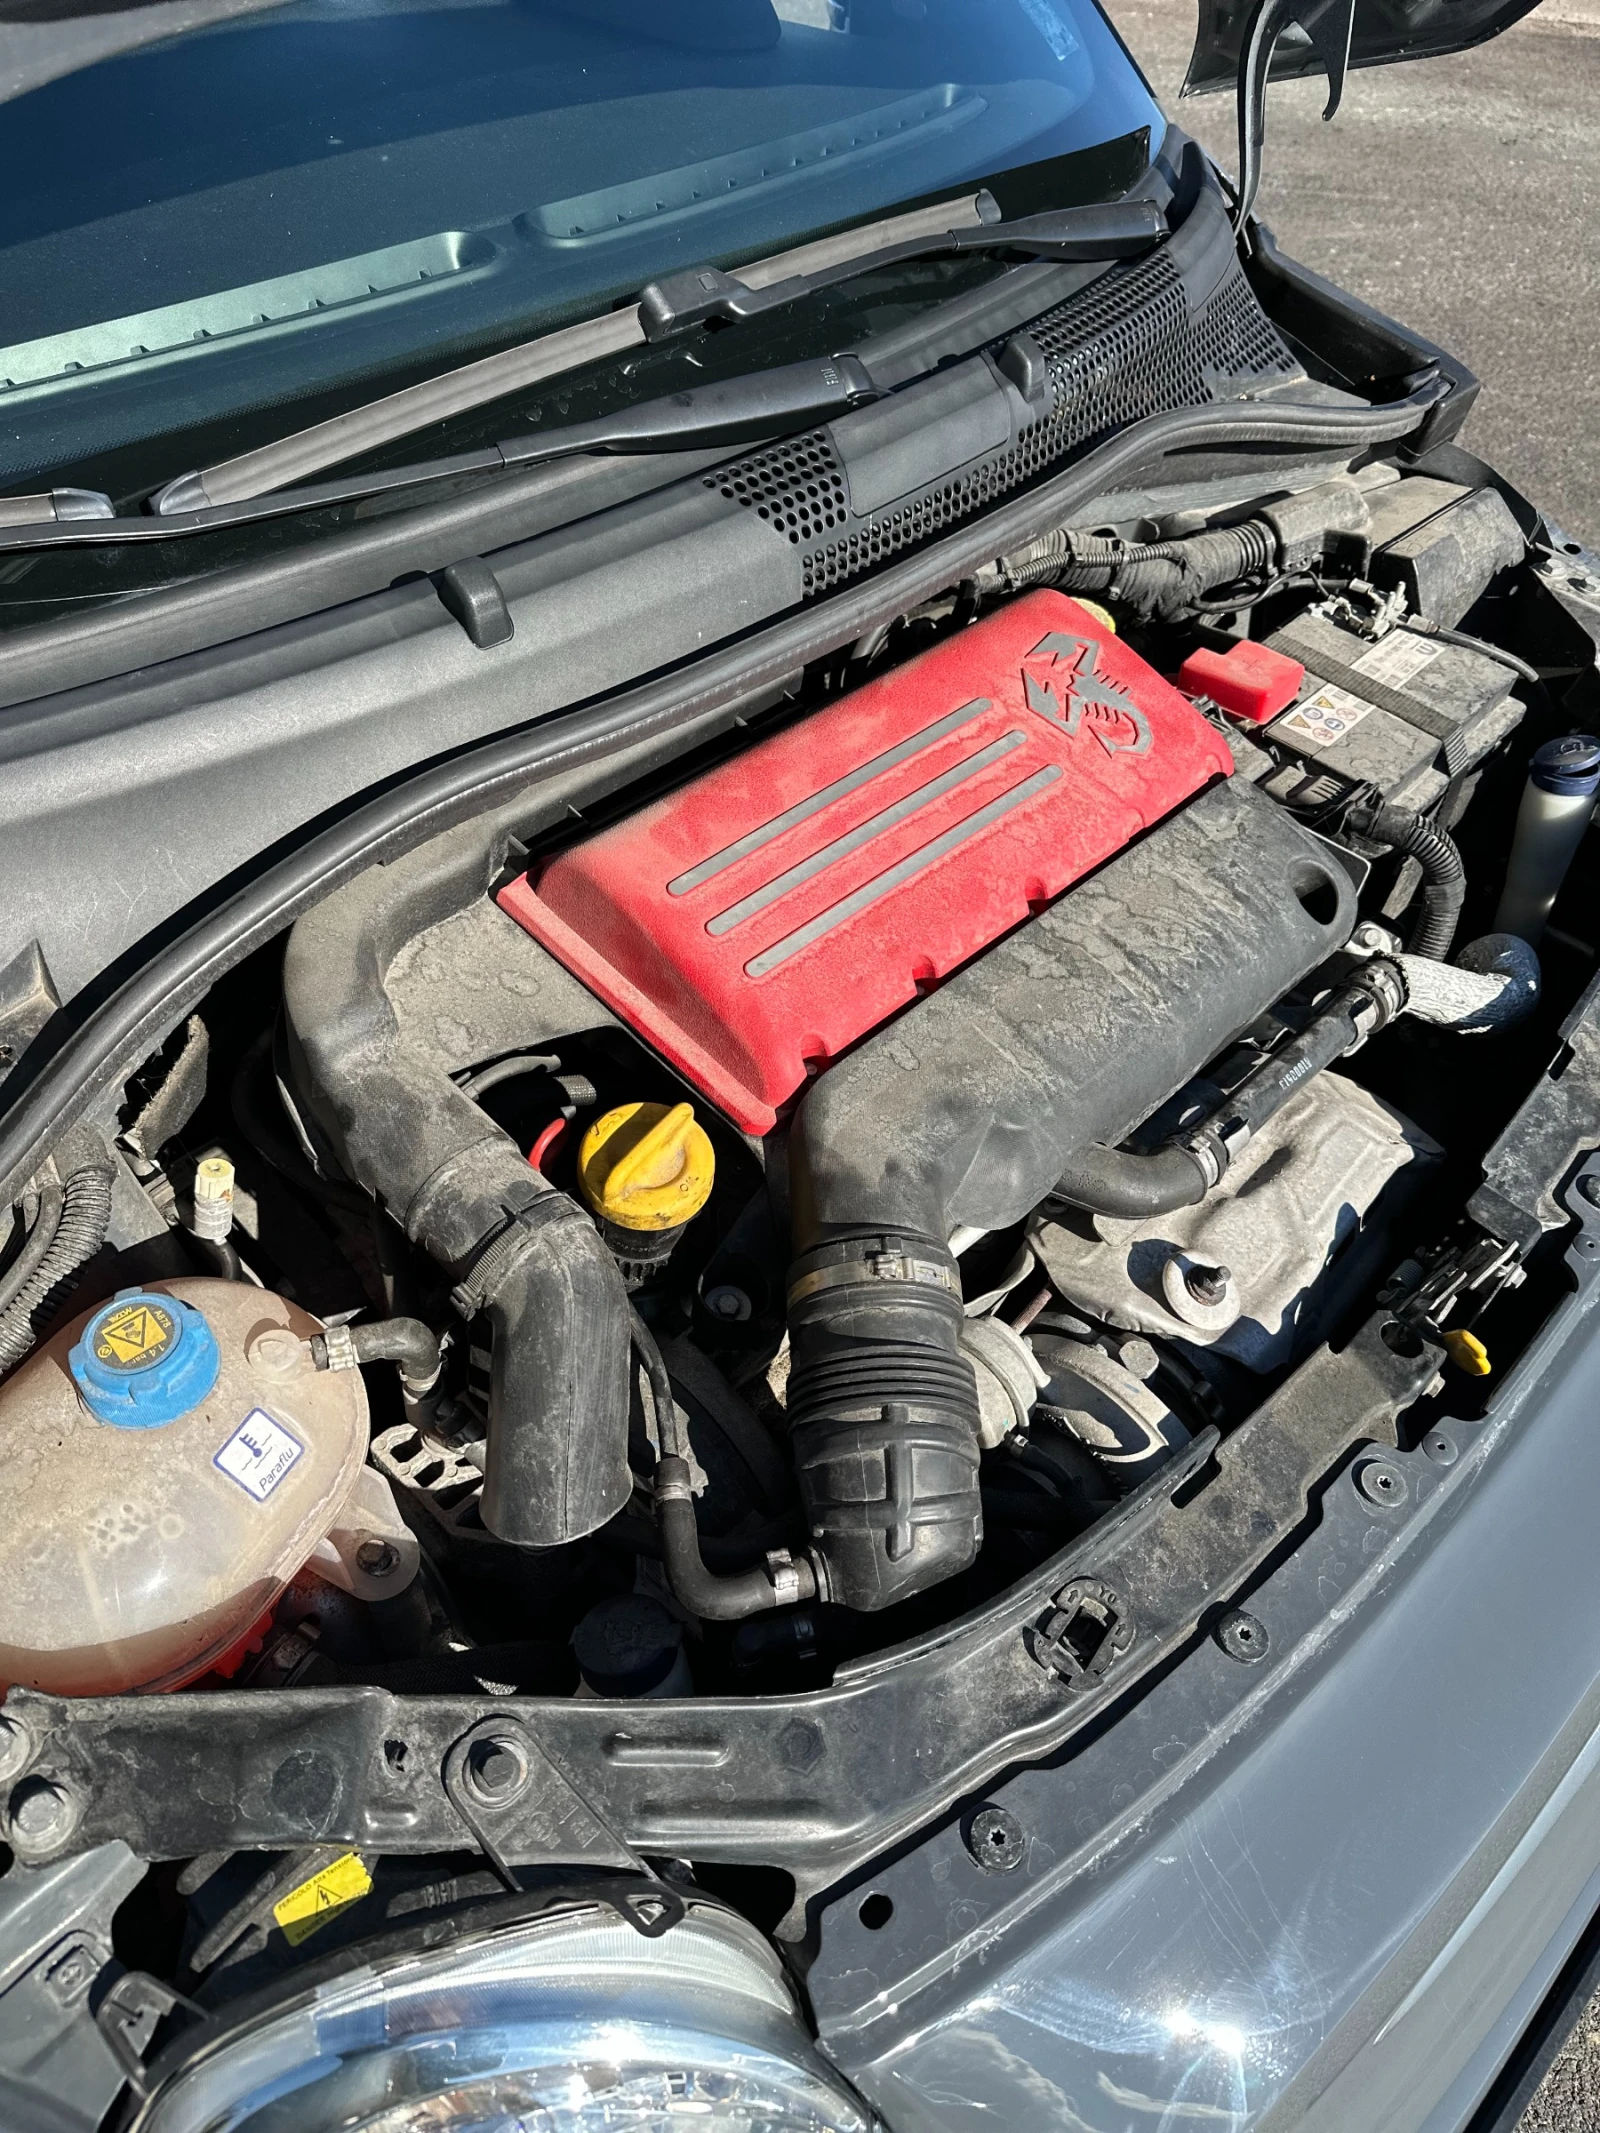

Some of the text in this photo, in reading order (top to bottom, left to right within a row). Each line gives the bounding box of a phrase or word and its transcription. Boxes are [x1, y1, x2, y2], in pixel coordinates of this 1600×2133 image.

[132, 1344, 165, 1364] 1.4 bar
[259, 1447, 294, 1492] Paraflu
[278, 1884, 312, 1910] PERICOLO
